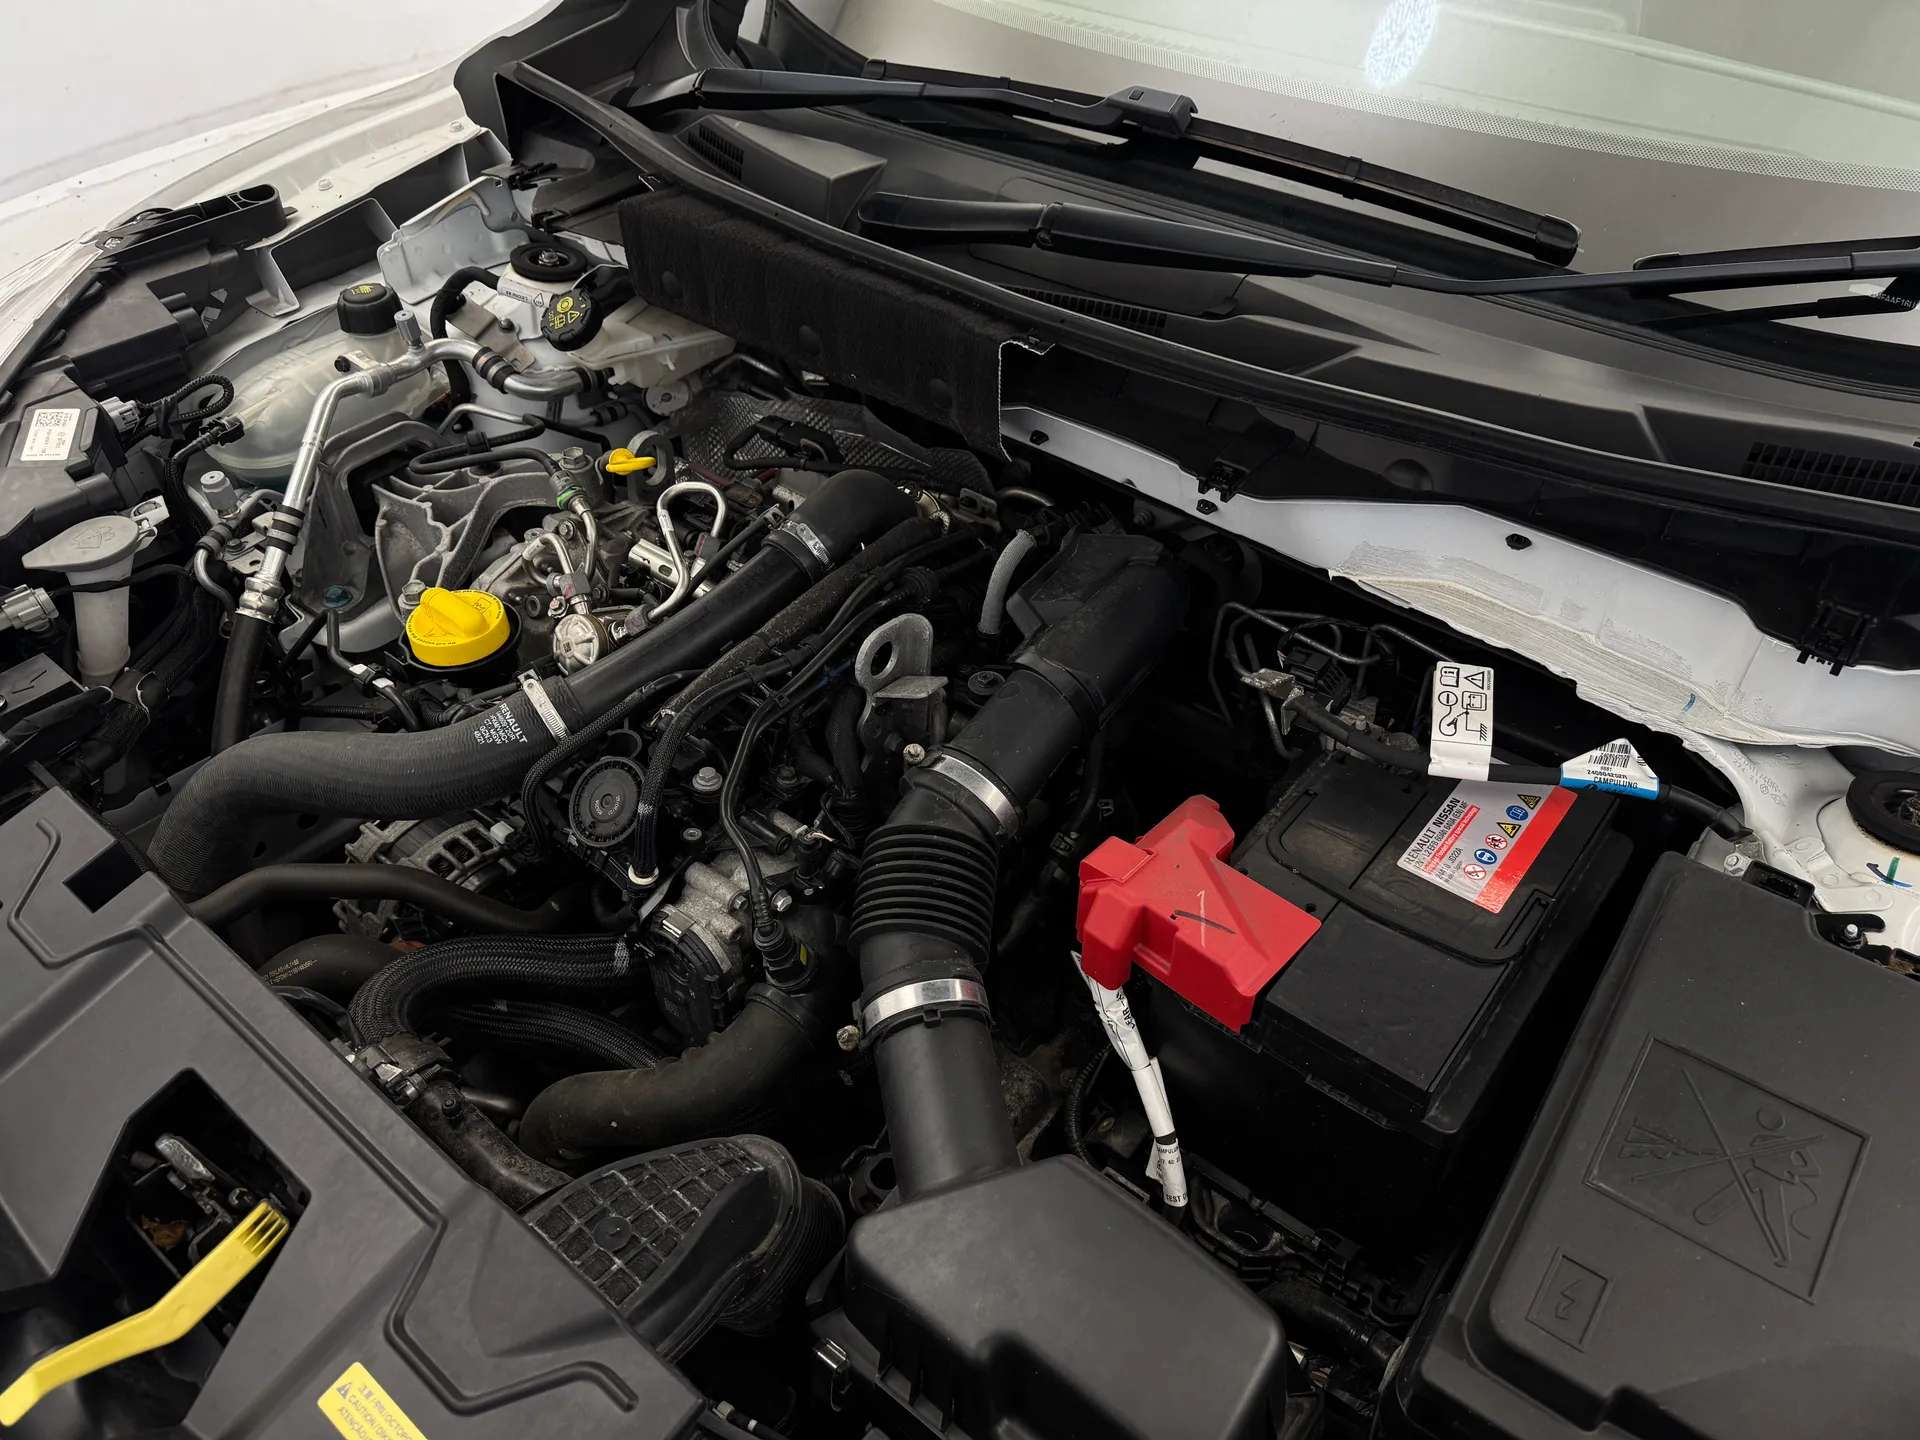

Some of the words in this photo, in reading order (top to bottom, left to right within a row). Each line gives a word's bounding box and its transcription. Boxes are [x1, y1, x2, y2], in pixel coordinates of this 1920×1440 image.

[499, 703, 528, 743] RENAULT
[1593, 776, 1638, 788] CAMPULUNG
[1404, 827, 1436, 864] RENAULT
[1432, 797, 1460, 827] NISSAN
[1427, 840, 1439, 851] EFB
[348, 1394, 375, 1425] CAUTION
